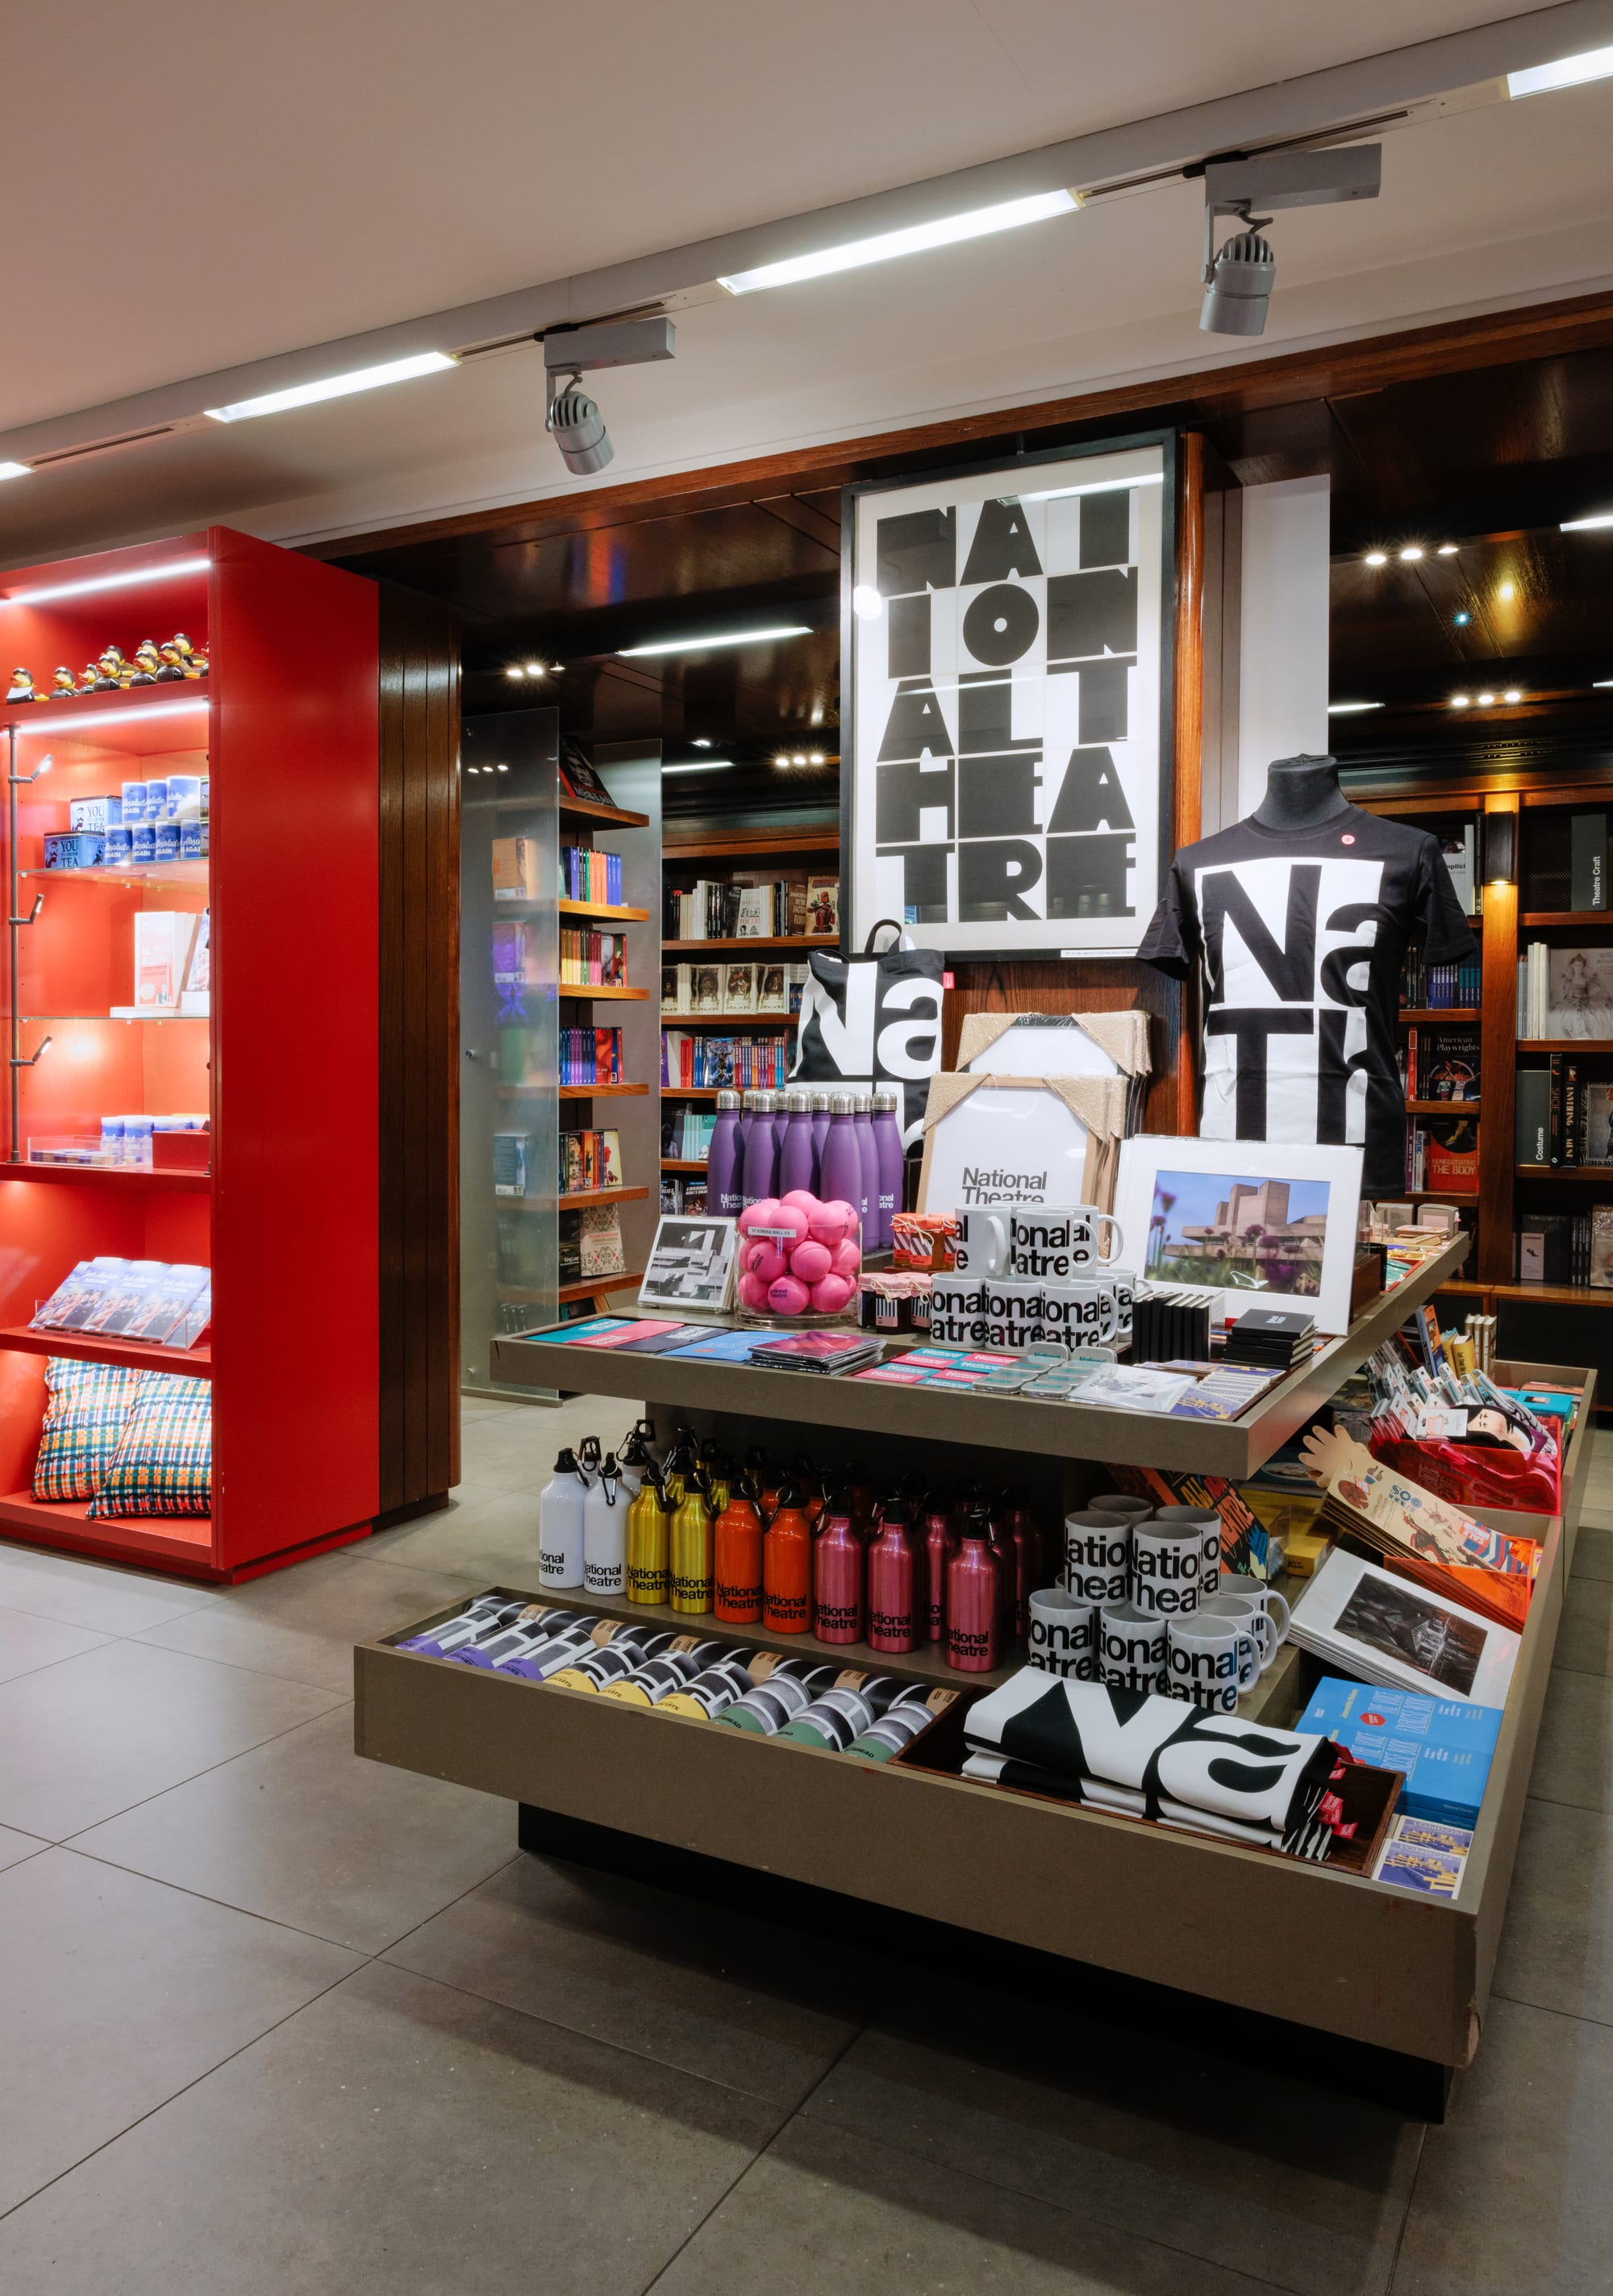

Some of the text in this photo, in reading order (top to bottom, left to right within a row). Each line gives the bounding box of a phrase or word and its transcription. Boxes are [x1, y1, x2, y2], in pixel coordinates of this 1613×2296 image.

[60, 840, 78, 852] YOU
[60, 858, 78, 867] TEA
[1593, 855, 1601, 906] Theatre Craft
[1436, 1044, 1481, 1053] Playwrights
[1536, 1127, 1544, 1161] Costume
[1432, 1165, 1477, 1175] THE BODY
[962, 1167, 1048, 1191] National
[1414, 1821, 1464, 1836] LONDON
[1400, 1844, 1453, 1860] LONDON
